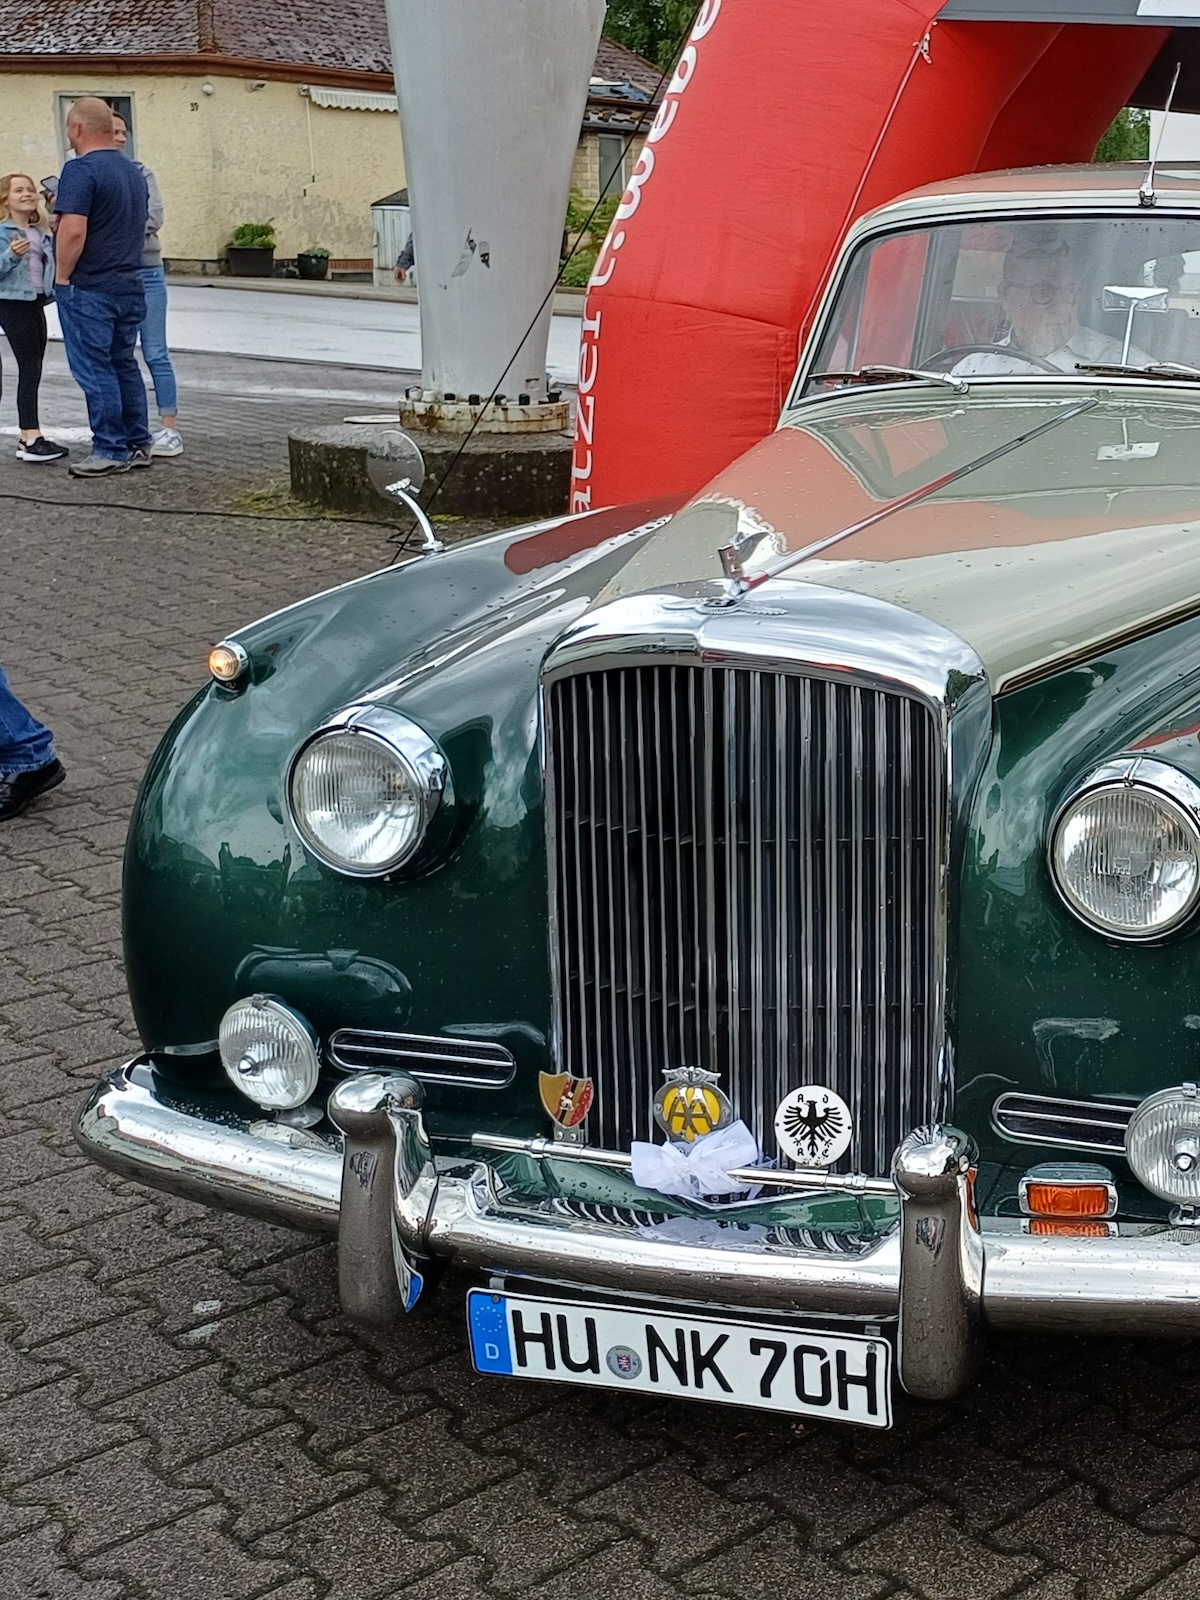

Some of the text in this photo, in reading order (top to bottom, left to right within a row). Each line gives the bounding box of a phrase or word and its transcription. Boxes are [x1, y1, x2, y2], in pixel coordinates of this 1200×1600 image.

[485, 1342, 499, 1359] D
[511, 1309, 600, 1375] HU
[644, 1323, 734, 1393] NK
[749, 1337, 879, 1416] 70H
